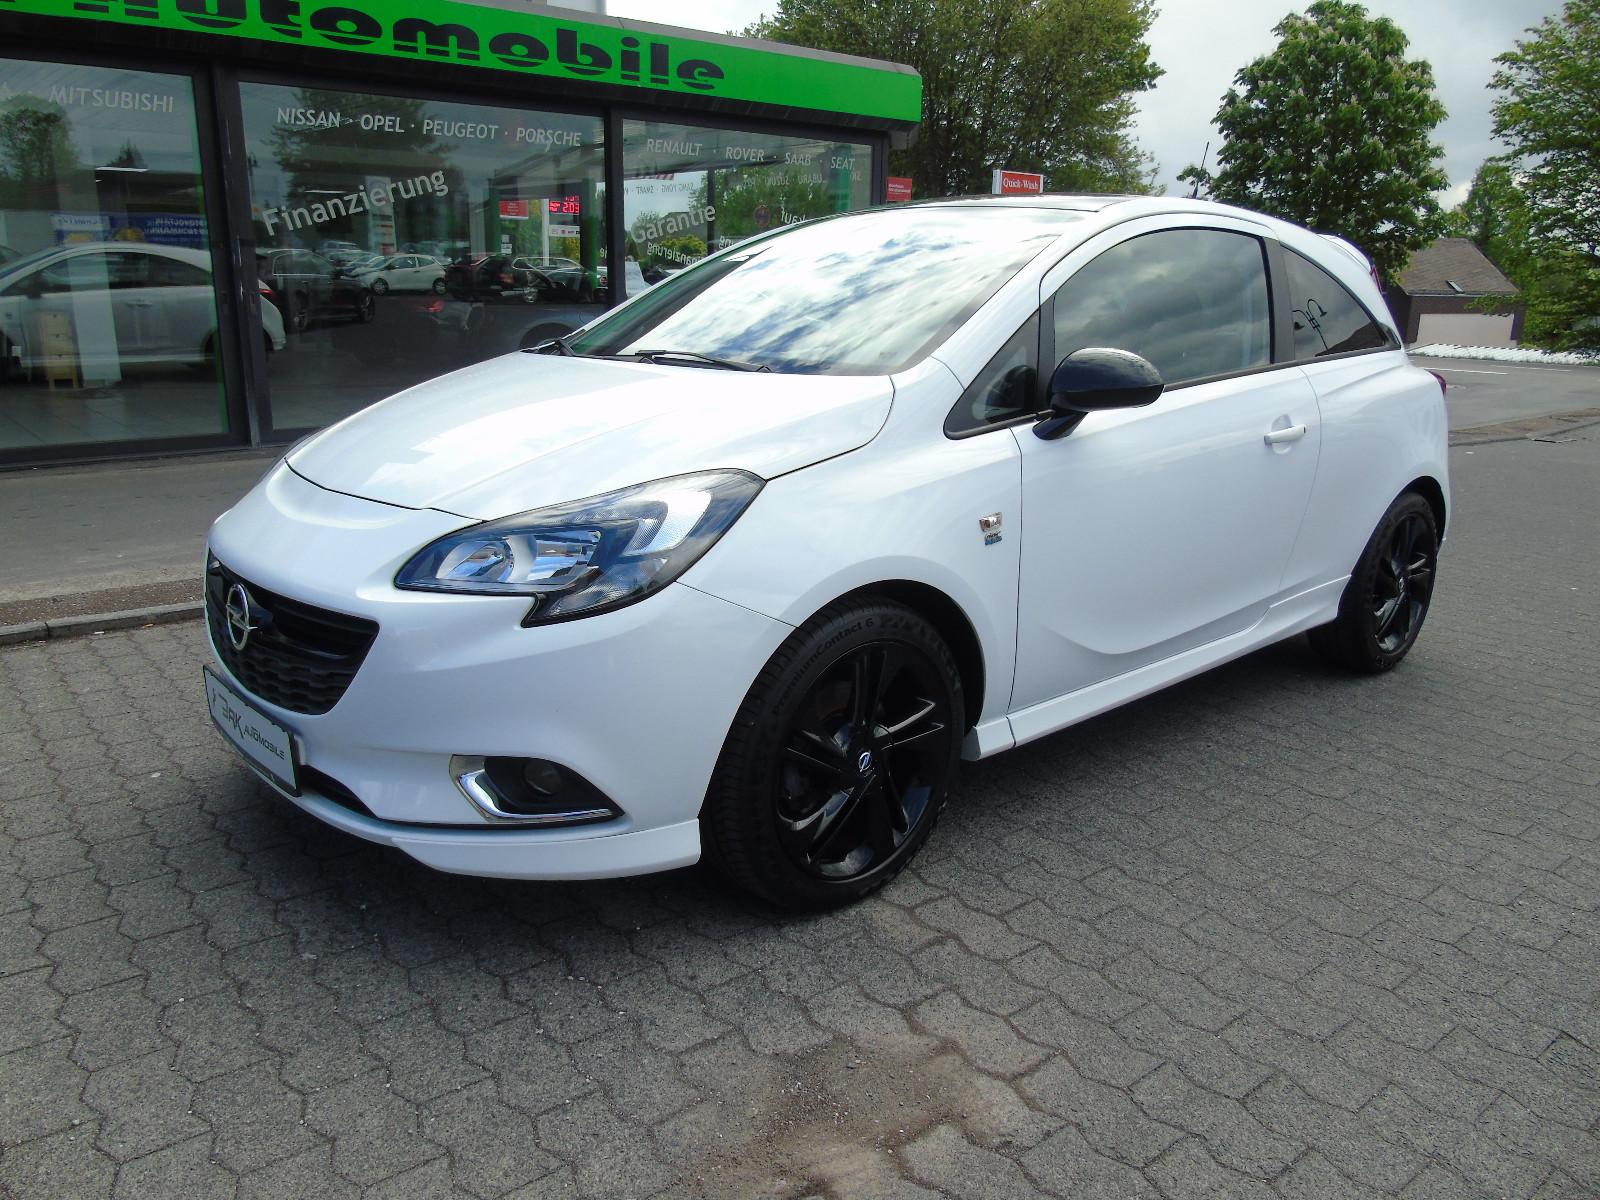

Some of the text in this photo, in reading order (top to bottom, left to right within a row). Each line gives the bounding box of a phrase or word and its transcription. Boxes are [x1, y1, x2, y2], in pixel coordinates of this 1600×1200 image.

[48, 86, 174, 113] MITSUBISHI
[277, 107, 582, 147] NISSAN OPEL PEUGEOT PORSCHE
[647, 138, 856, 170] RENAULT ROVER SAAB SEAT
[261, 169, 449, 236] Finanzierung
[630, 205, 716, 244] Garantie
